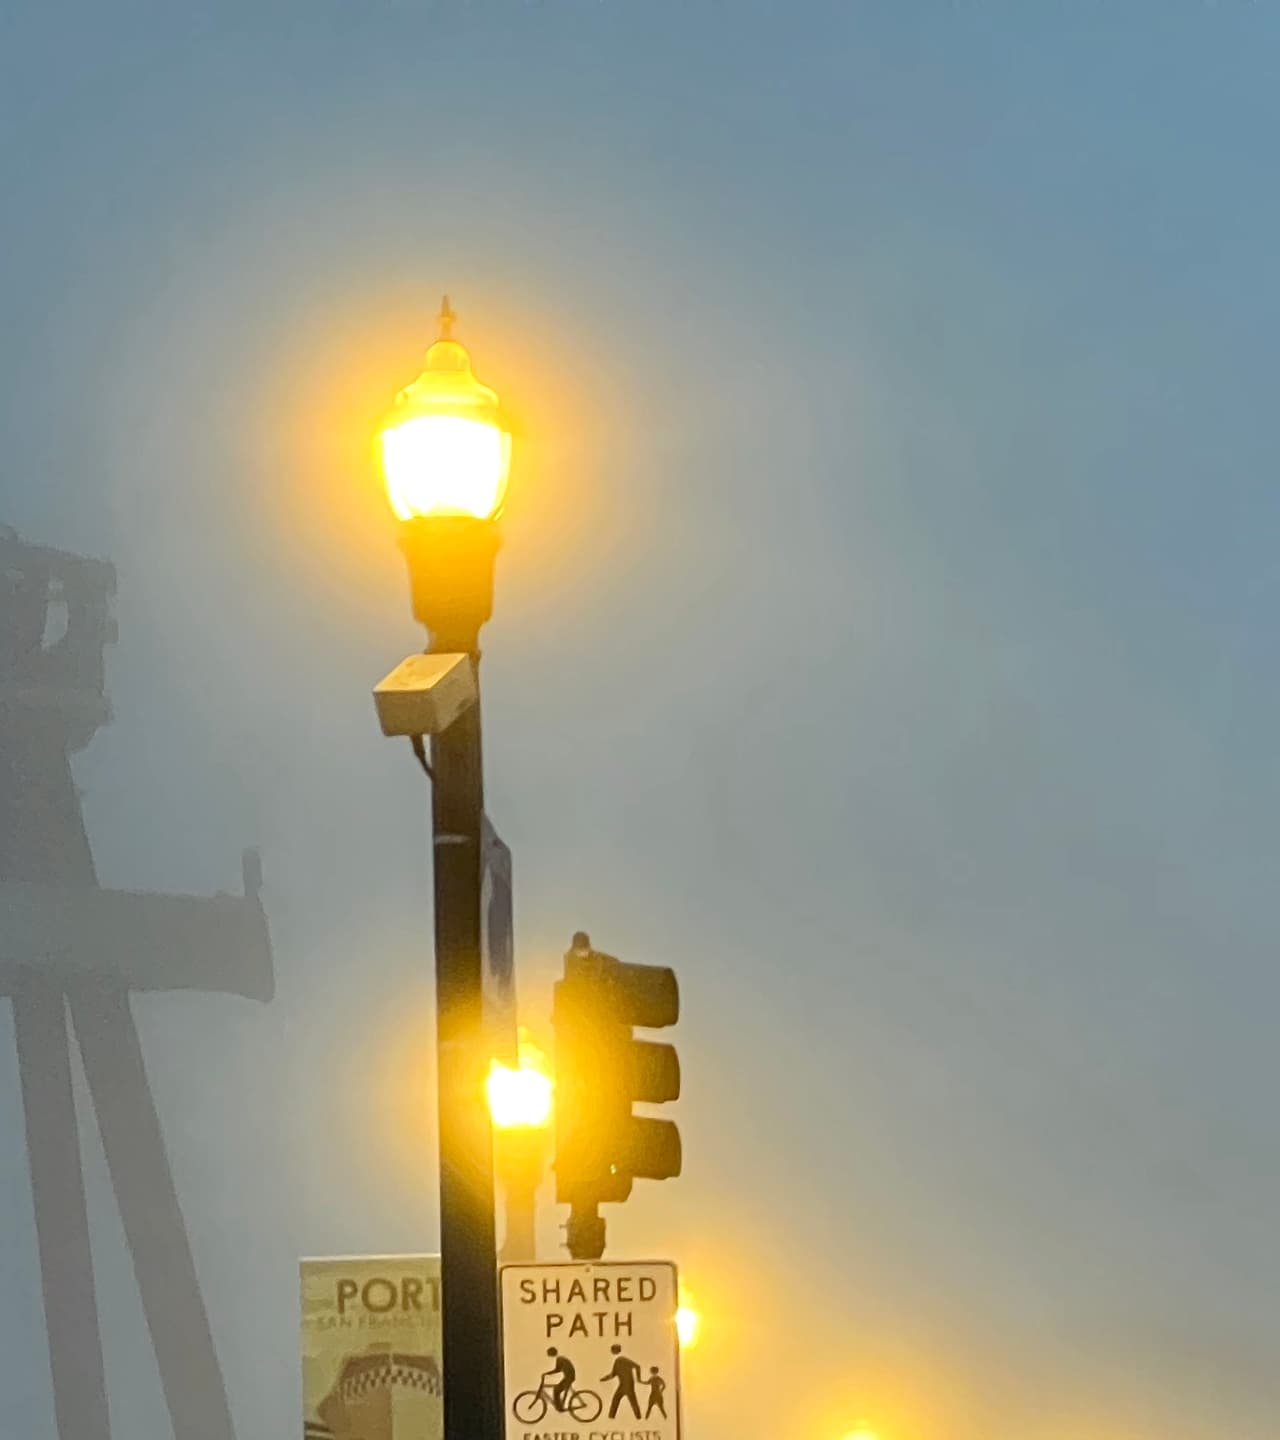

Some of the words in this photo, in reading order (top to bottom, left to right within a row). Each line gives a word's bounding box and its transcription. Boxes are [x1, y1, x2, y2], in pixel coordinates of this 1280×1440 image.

[336, 1277, 440, 1314] PORT
[519, 1276, 657, 1304] SHARED
[546, 1311, 633, 1338] PATH
